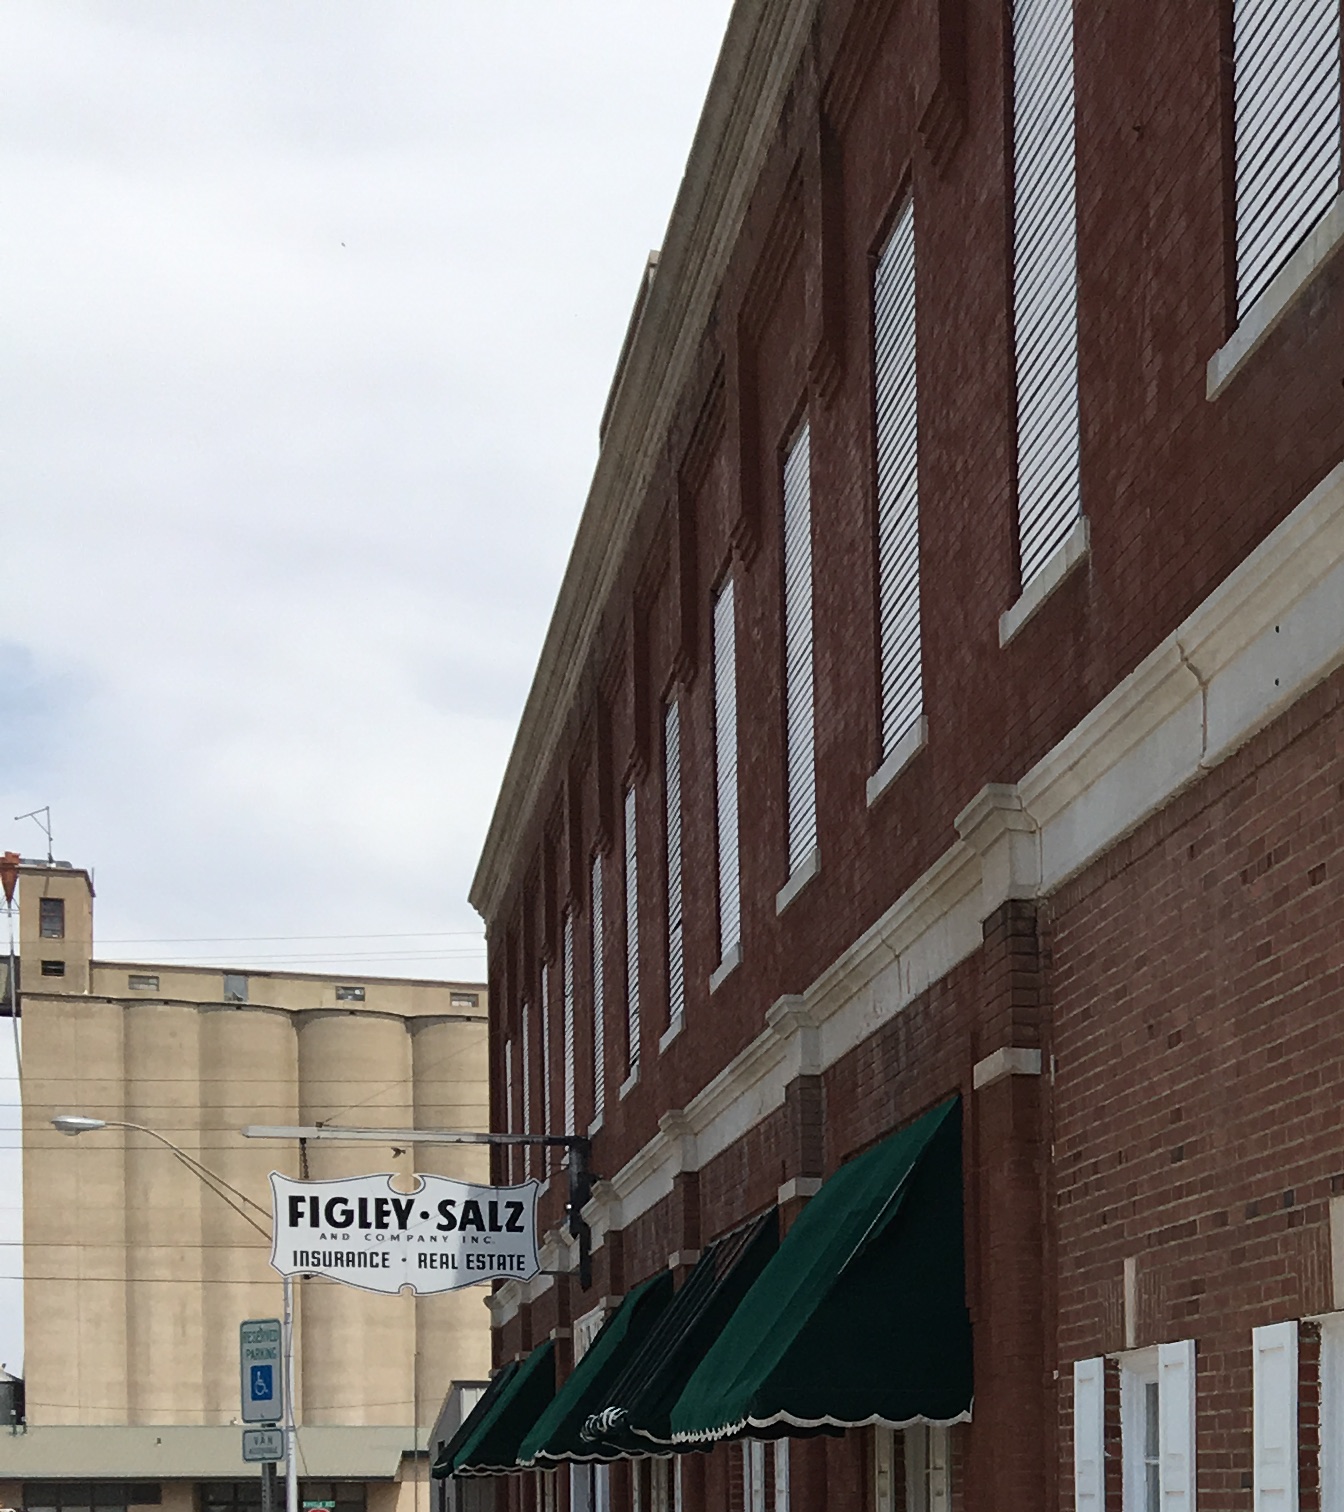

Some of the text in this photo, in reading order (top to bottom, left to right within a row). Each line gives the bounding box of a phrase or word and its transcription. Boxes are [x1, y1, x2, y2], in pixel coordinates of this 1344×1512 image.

[288, 1195, 525, 1232] FIGLEY SALZ
[319, 1233, 496, 1244] AND COMPANY INC.
[293, 1250, 526, 1271] INSURANCE REAL ESTATE
